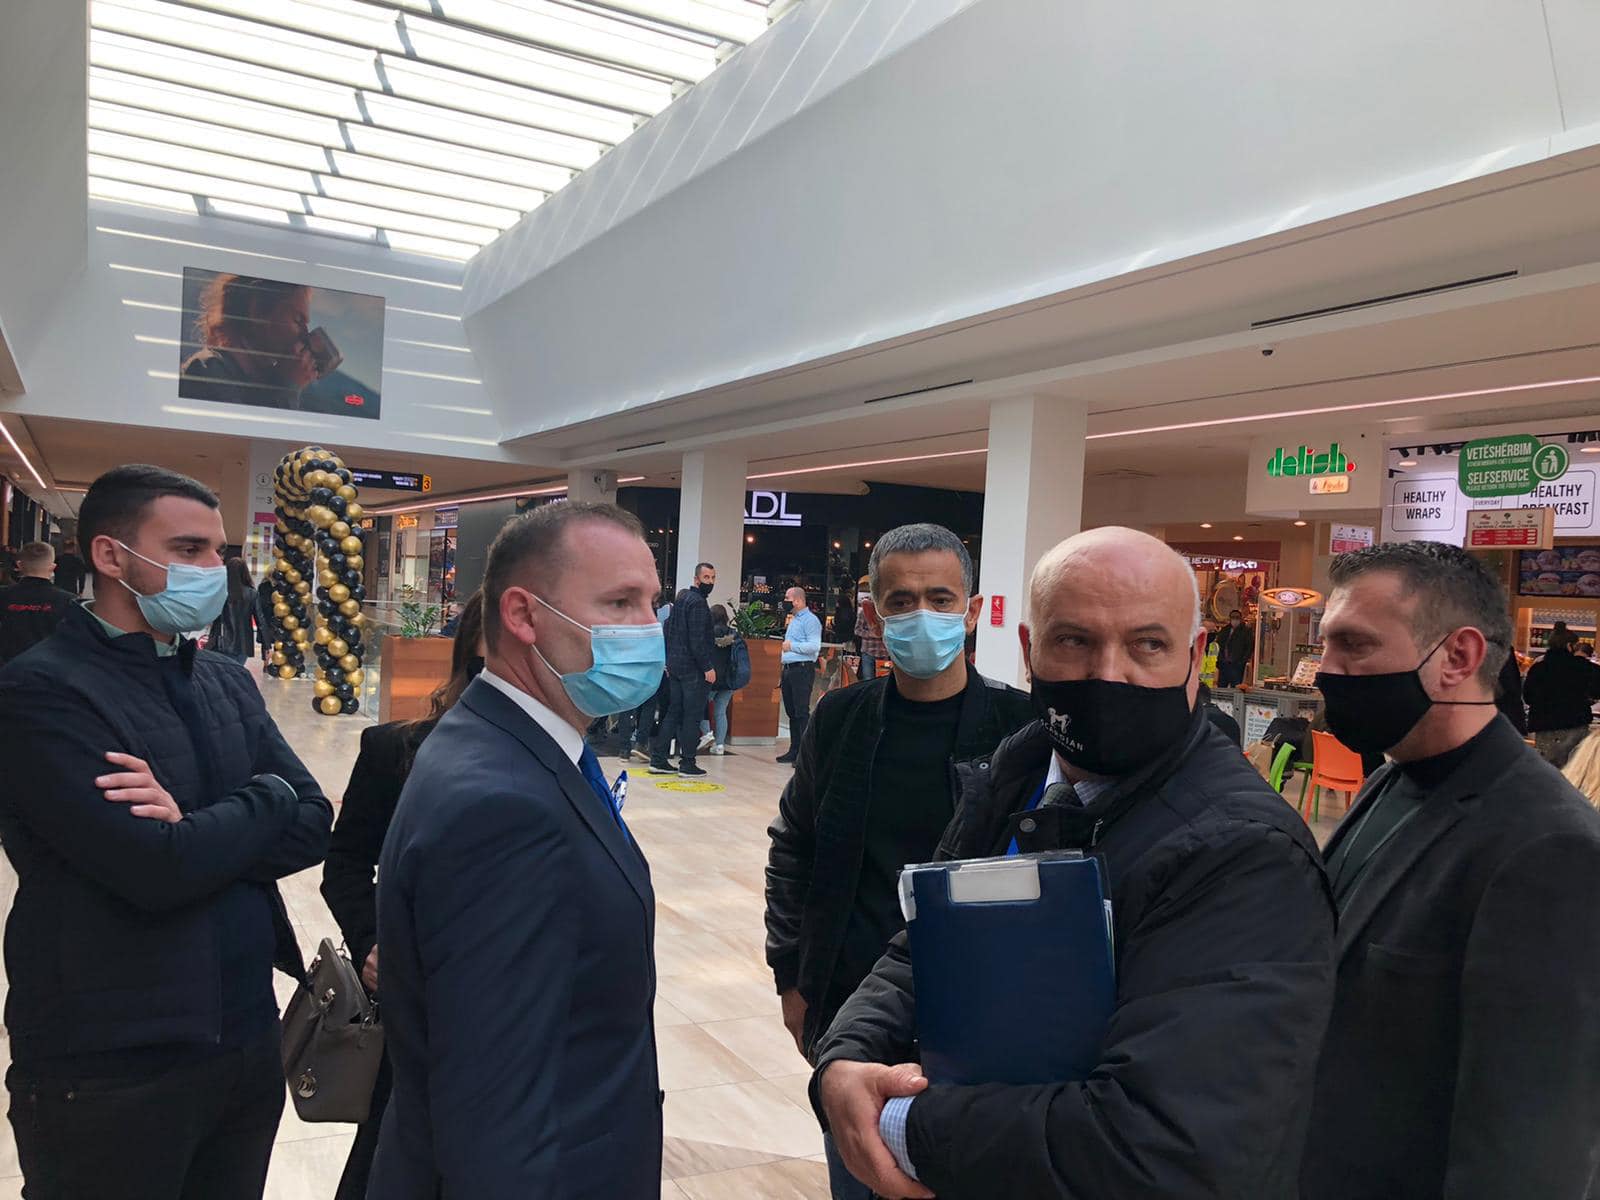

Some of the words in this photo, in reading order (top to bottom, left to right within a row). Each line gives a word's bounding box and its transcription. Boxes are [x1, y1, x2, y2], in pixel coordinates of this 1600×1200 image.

[1467, 442, 1532, 460] VETËSHËRBIM
[1467, 468, 1529, 485] SELFSERVICE
[424, 480, 430, 490] 3
[1530, 484, 1583, 498] HEALTHY
[1403, 490, 1446, 504] HEALTHY
[744, 491, 802, 519] DL
[1406, 507, 1442, 520] WRAPS
